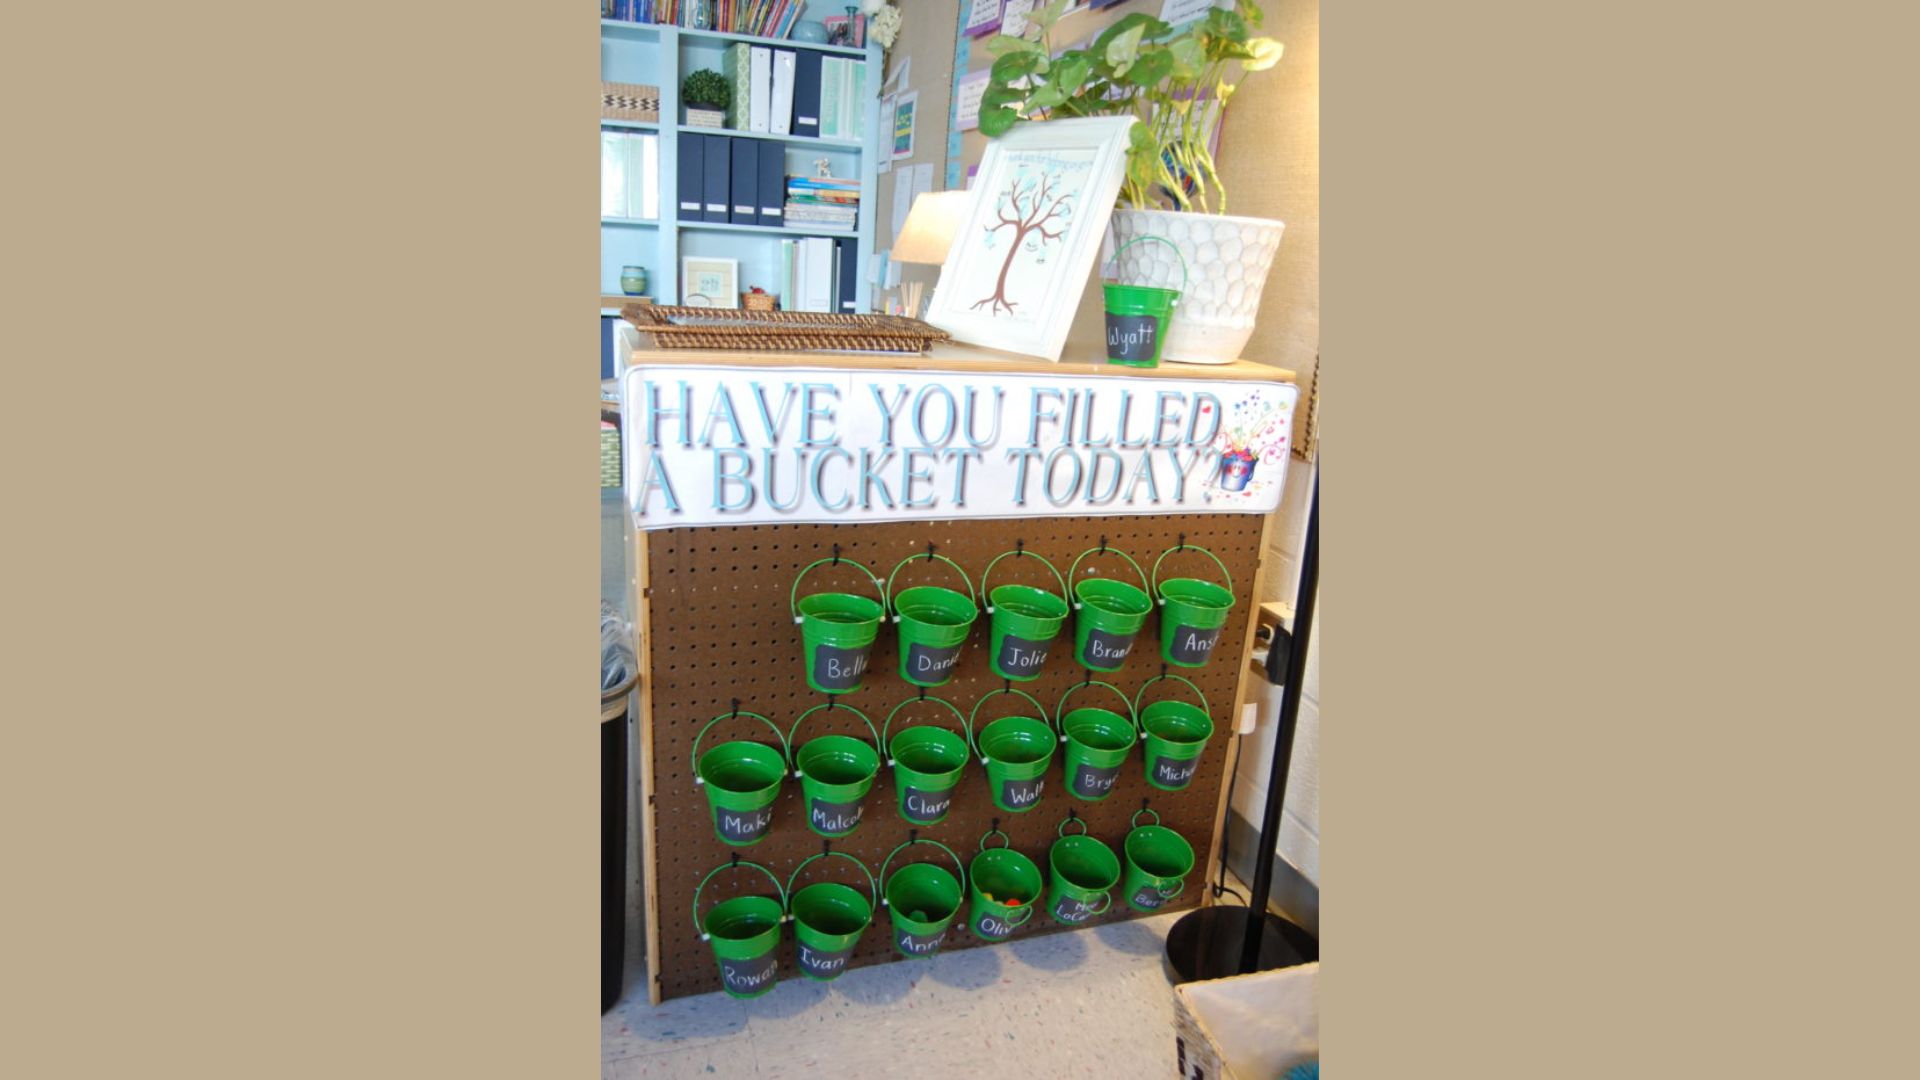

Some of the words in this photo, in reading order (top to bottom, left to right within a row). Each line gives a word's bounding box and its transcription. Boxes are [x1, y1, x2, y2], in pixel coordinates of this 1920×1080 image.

[644, 380, 840, 447] HAVE
[868, 383, 1005, 448] YOU
[1027, 386, 1222, 447] FILLED
[632, 450, 681, 516] A
[711, 447, 984, 513] BUCKET
[1005, 445, 1223, 507] TODAY?
[1008, 647, 1048, 667] Jolie
[801, 946, 845, 970] Ivan
[725, 959, 778, 987] Rowan
